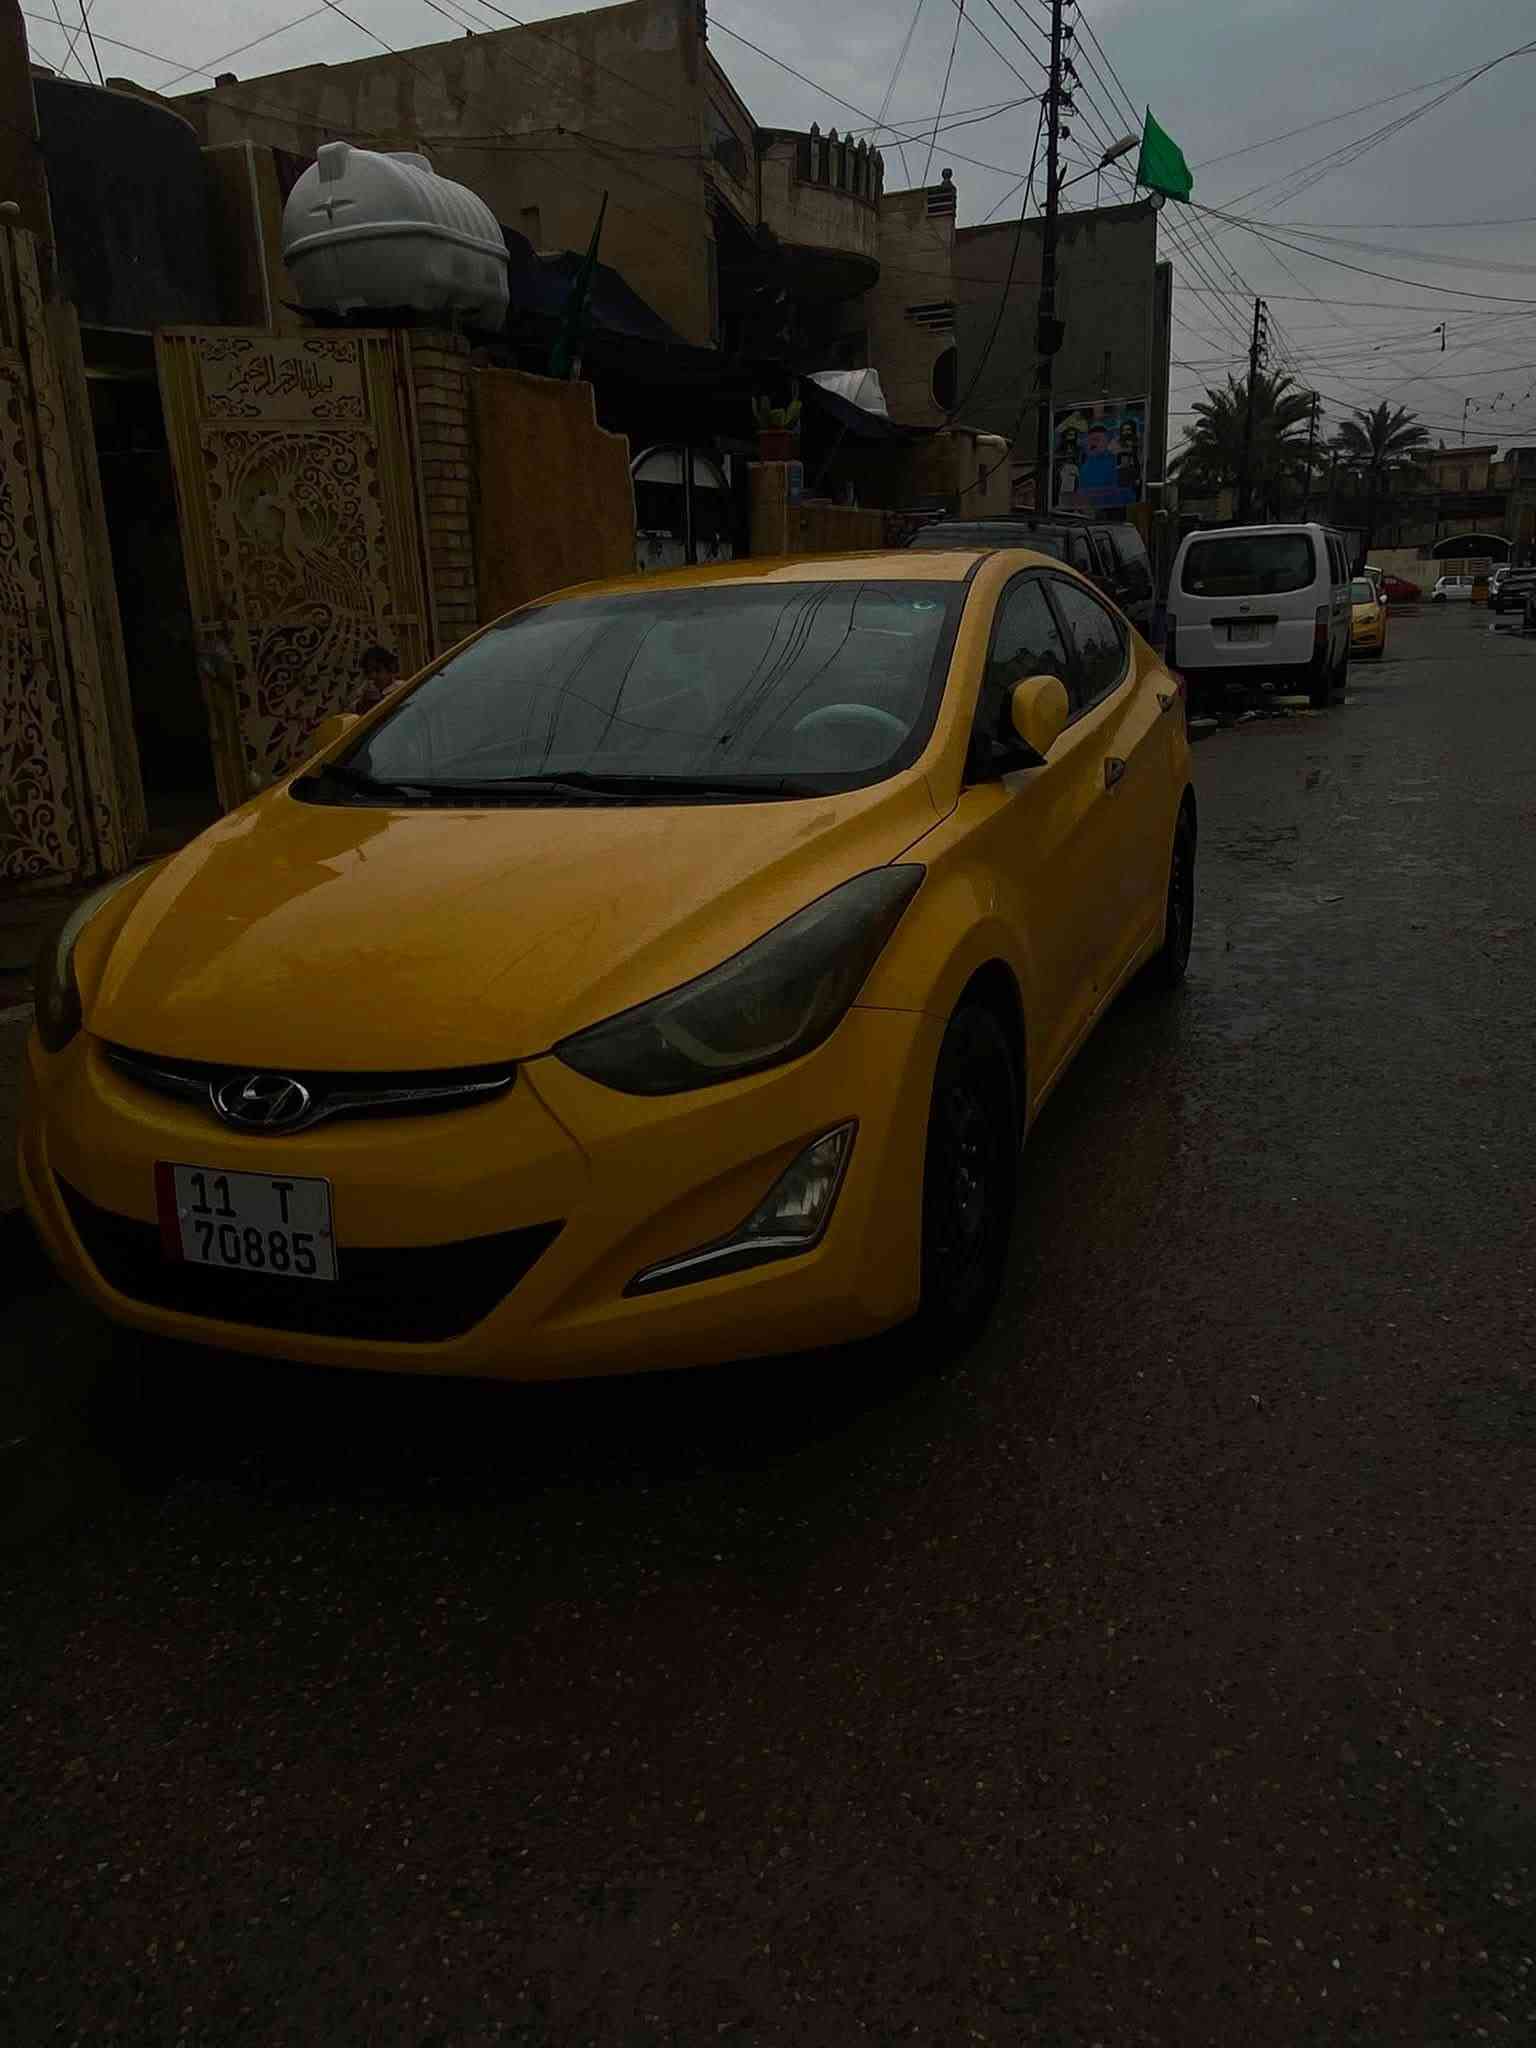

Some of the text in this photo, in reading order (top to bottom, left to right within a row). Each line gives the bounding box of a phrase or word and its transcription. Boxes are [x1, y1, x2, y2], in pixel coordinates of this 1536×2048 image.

[191, 1172, 294, 1223] 11 T
[195, 1220, 316, 1274] 70885
